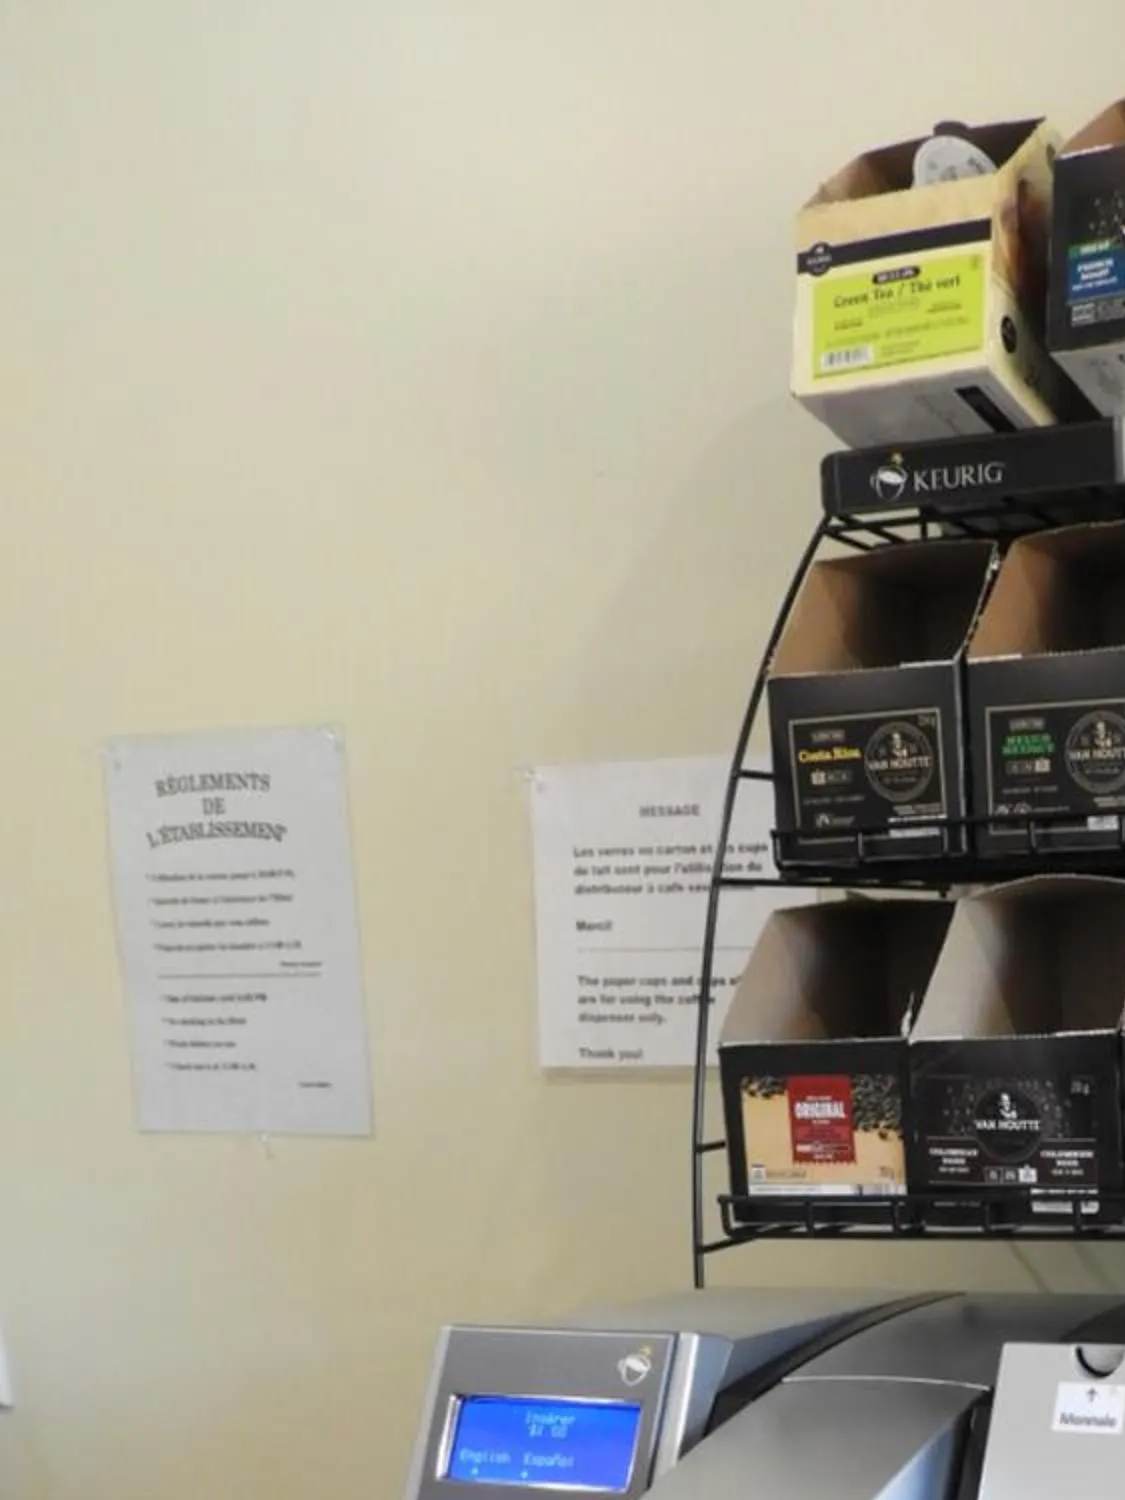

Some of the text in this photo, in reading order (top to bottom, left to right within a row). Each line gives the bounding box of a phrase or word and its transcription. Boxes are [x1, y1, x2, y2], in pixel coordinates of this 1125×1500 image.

[833, 291, 869, 308] Green
[873, 288, 895, 302] Tea
[912, 460, 1005, 493] KEURIG
[798, 746, 862, 764] Costa Rica
[202, 797, 226, 815] DE
[639, 804, 700, 818] MESSAGE
[573, 847, 595, 859] Les
[656, 843, 697, 856] carton
[573, 865, 589, 877] de
[592, 864, 611, 876] lait
[643, 864, 671, 879] pour
[574, 882, 643, 896] distributeur
[575, 919, 614, 933] Merci!
[577, 975, 599, 988] The
[602, 976, 636, 990] paper
[639, 976, 668, 989] cups
[671, 975, 693, 987] and
[577, 994, 597, 1006] are
[600, 993, 617, 1005] for
[619, 993, 651, 1007] using
[654, 993, 675, 1005] the
[578, 1011, 635, 1026] dispenser
[579, 1048, 615, 1060] Thank
[974, 1119, 1041, 1131] VAN HOUTTE
[1059, 1412, 1117, 1428] Monnaie
[459, 1450, 575, 1468] English Español
